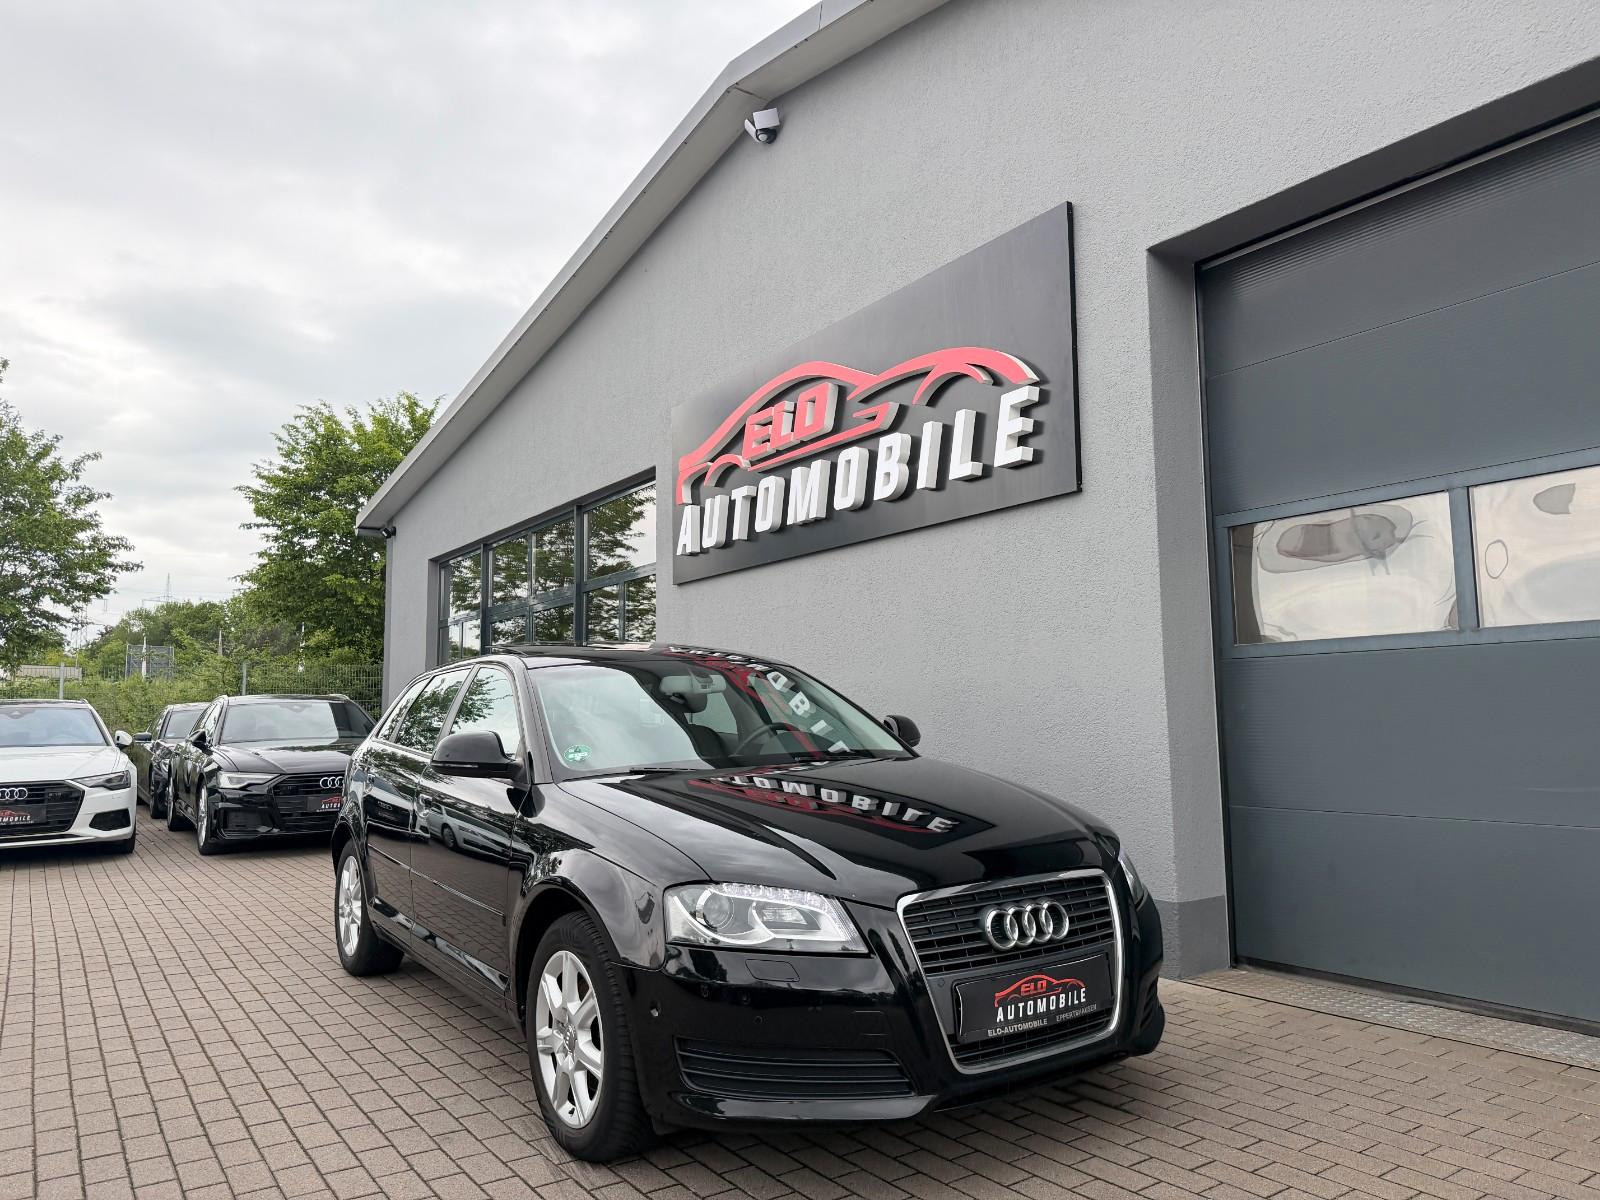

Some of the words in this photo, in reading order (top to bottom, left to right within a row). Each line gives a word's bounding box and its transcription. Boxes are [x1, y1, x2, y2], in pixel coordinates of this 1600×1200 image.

[742, 381, 840, 461] ELO
[676, 385, 1040, 556] AUTOMOBILE
[996, 987, 1087, 1023] AUTOMOBILE
[1020, 980, 1047, 996] ELO
[987, 1018, 1048, 1037] ELO-AUTOMOBILE
